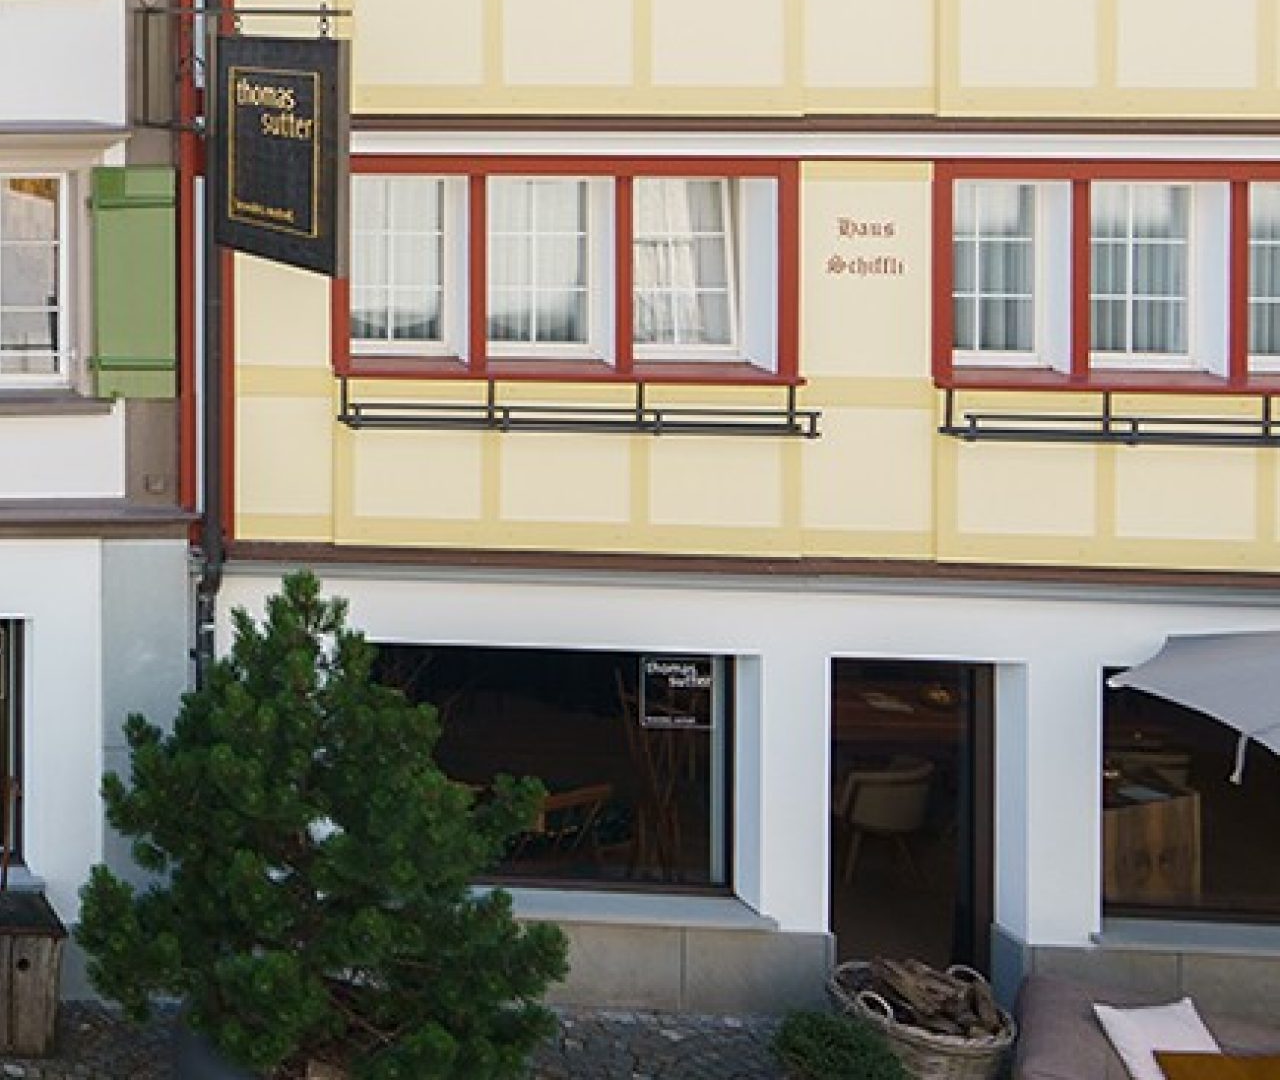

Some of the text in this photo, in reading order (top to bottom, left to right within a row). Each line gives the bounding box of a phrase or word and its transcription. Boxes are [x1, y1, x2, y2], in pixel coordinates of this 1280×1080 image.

[236, 78, 297, 109] thomas
[260, 112, 312, 139] sutter
[836, 216, 896, 239] Haus
[646, 662, 698, 676] thomas
